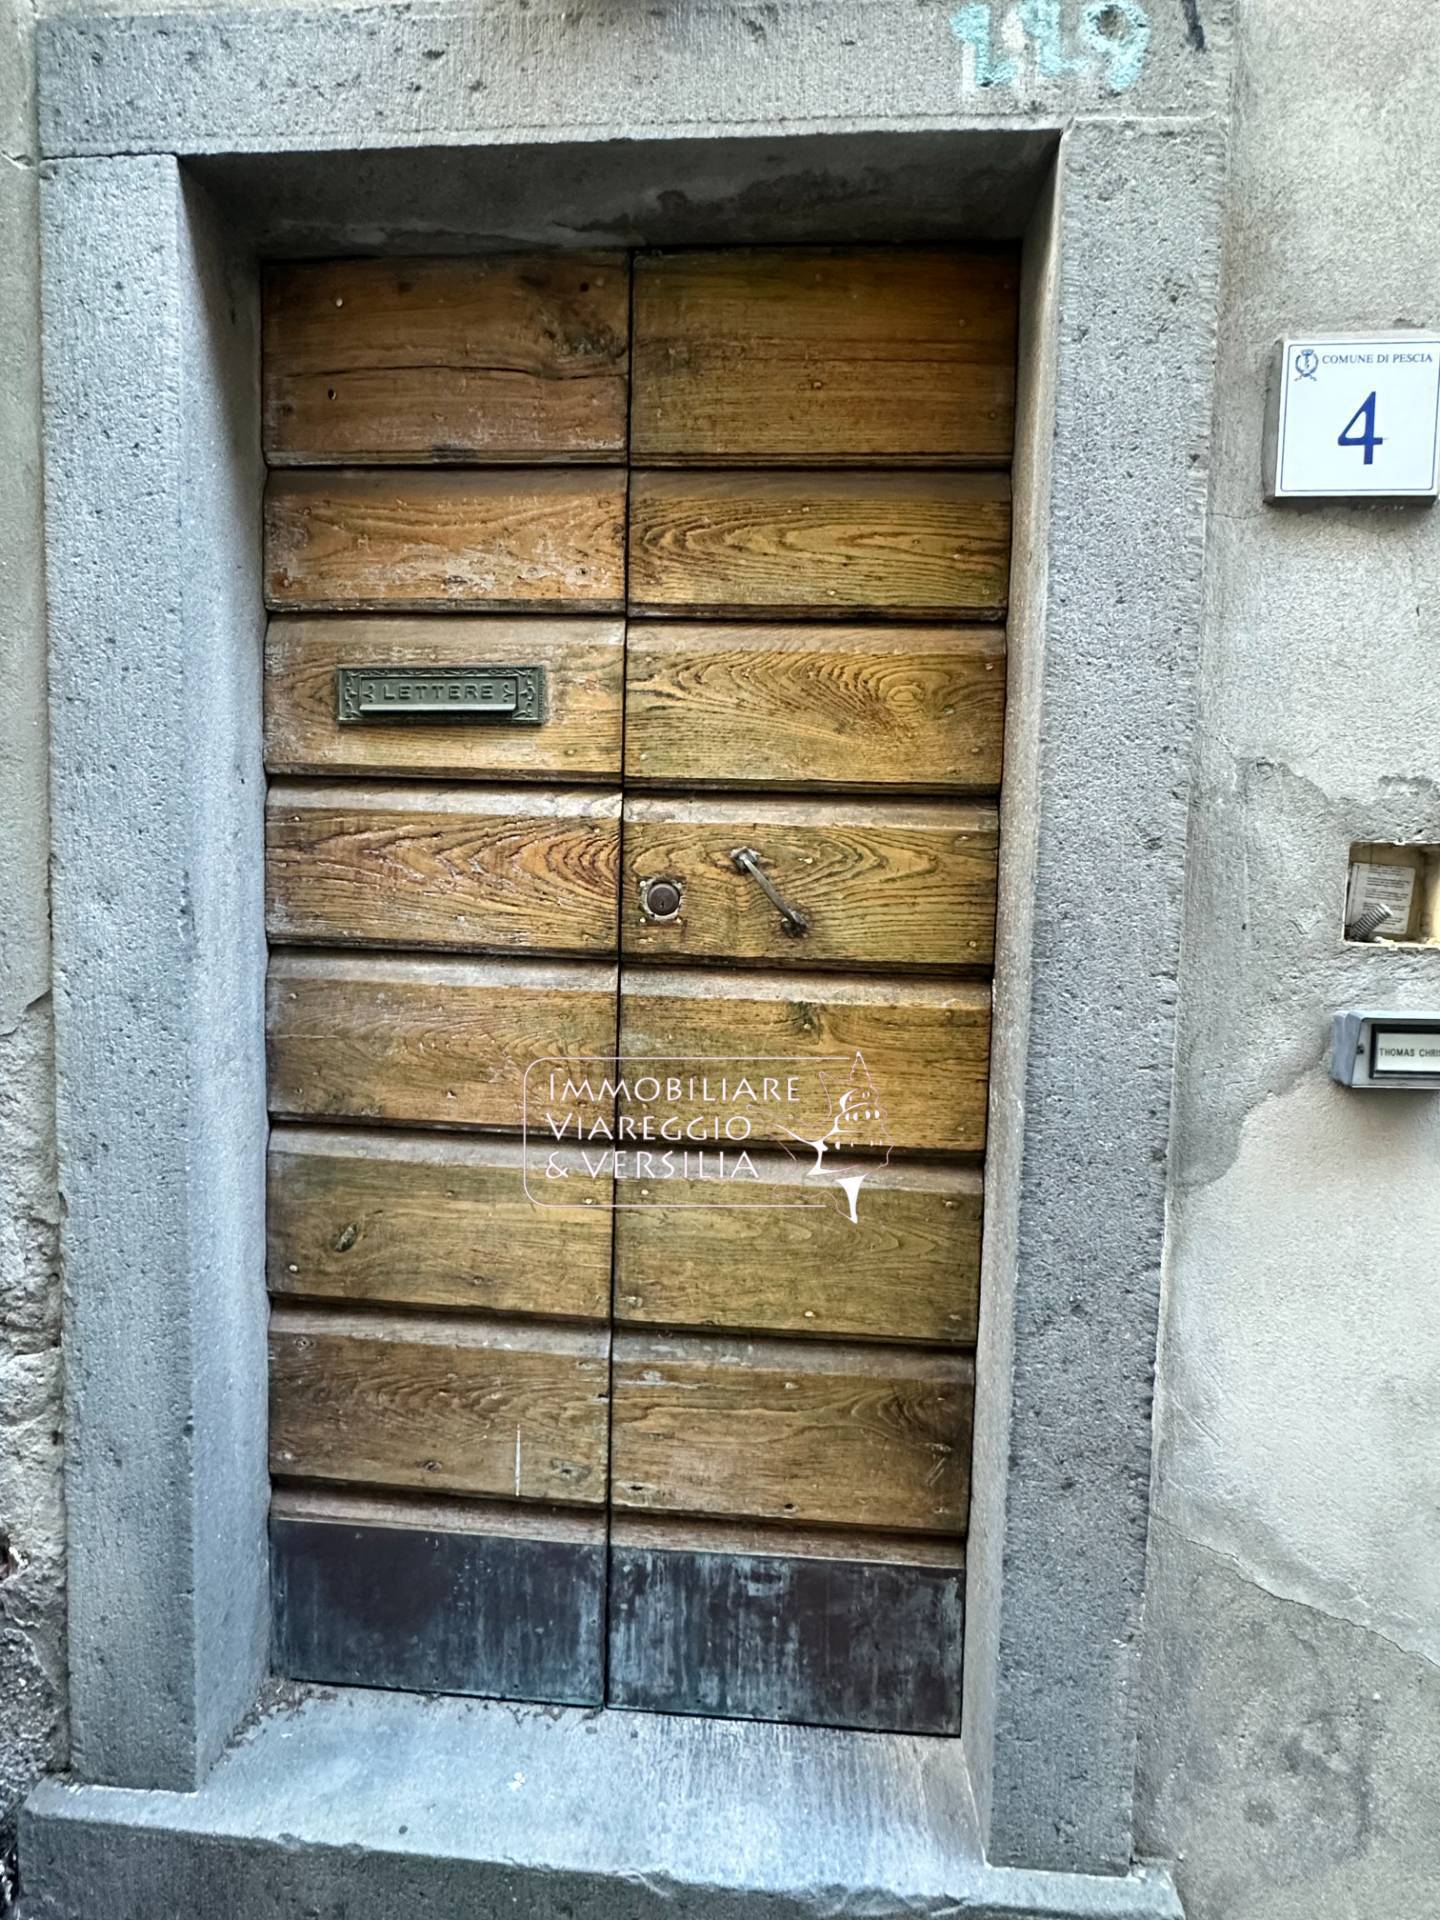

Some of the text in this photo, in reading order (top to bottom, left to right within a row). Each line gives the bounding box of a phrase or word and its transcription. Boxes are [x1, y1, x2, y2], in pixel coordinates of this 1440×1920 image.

[1322, 353, 1433, 364] COMUNE DI PESCIA
[1337, 391, 1383, 465] 4
[383, 682, 494, 700] LETTERE
[1380, 1048, 1415, 1057] THOMAS
